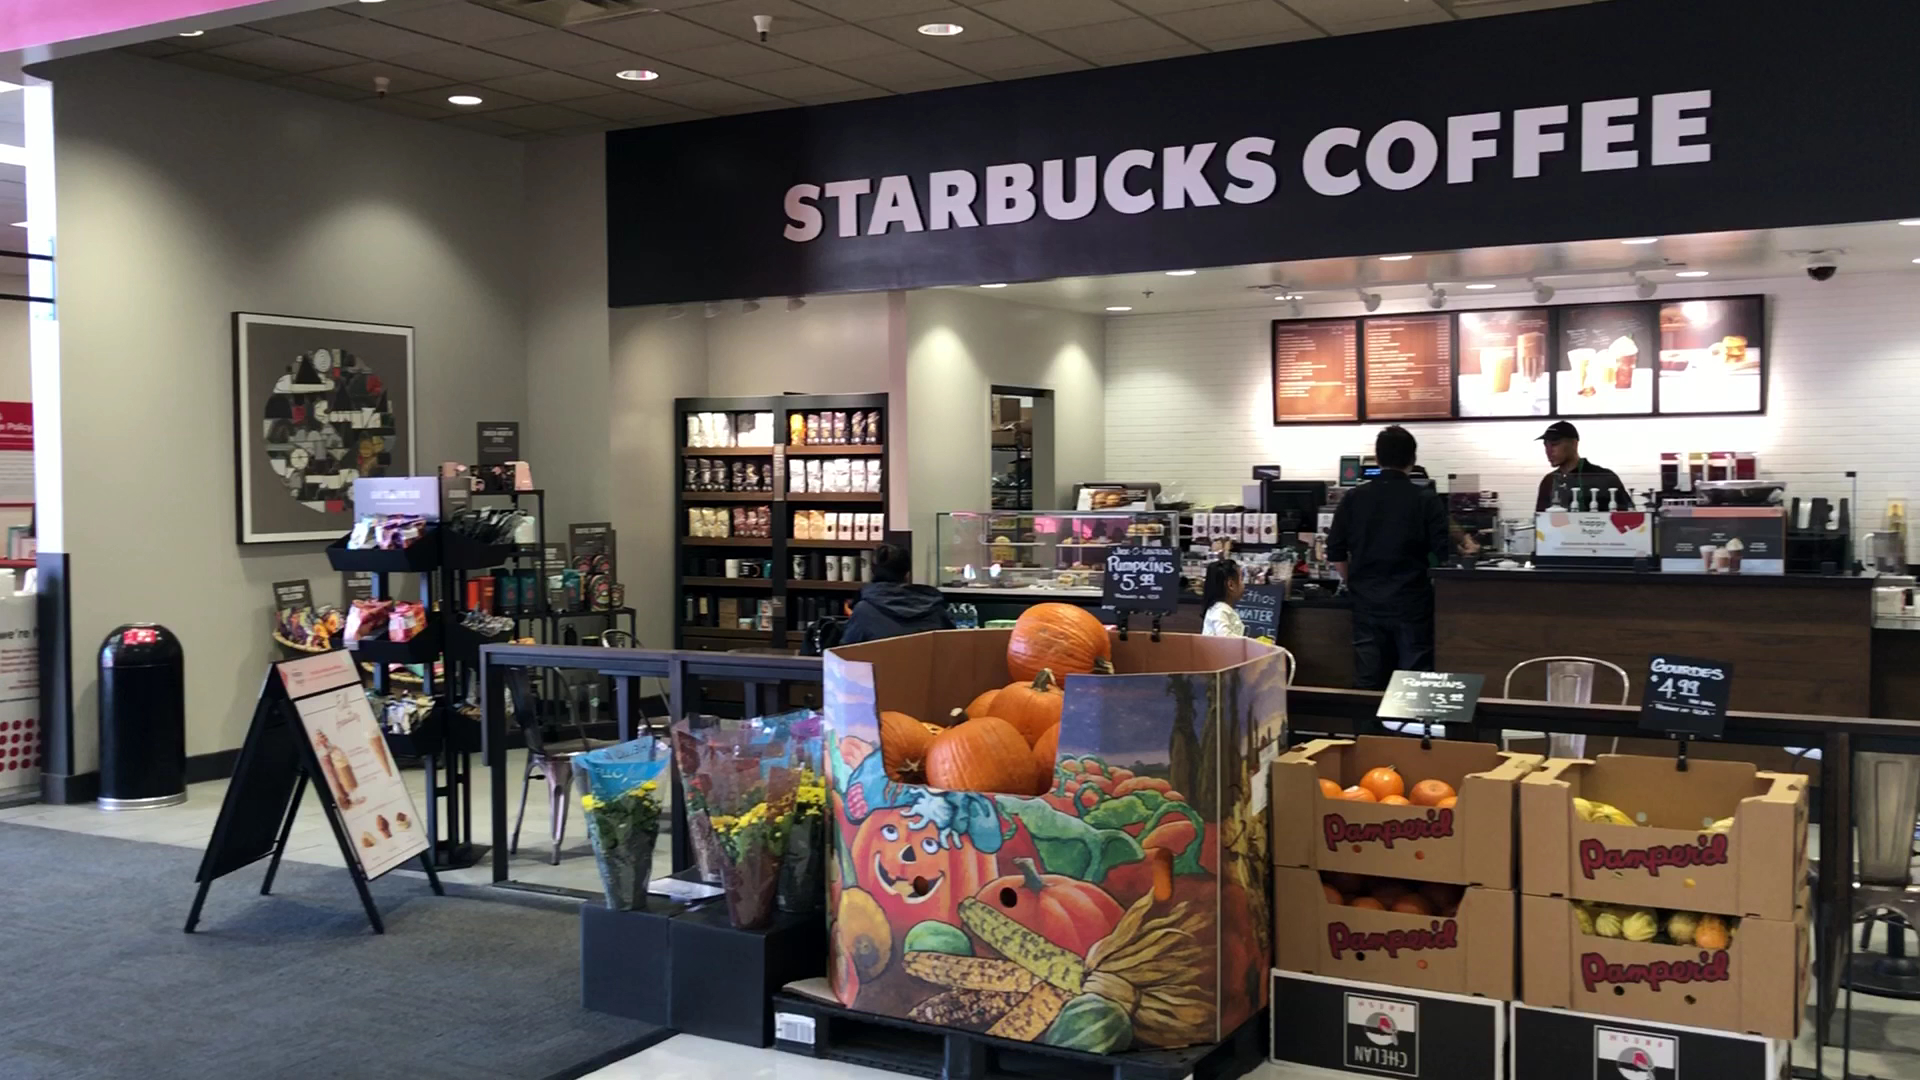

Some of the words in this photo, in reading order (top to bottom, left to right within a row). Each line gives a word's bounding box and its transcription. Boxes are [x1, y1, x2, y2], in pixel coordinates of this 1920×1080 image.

[783, 136, 1278, 242] STARBUCKS
[1302, 89, 1712, 196] COFFEE
[1354, 1045, 1408, 1068] CHELAN
